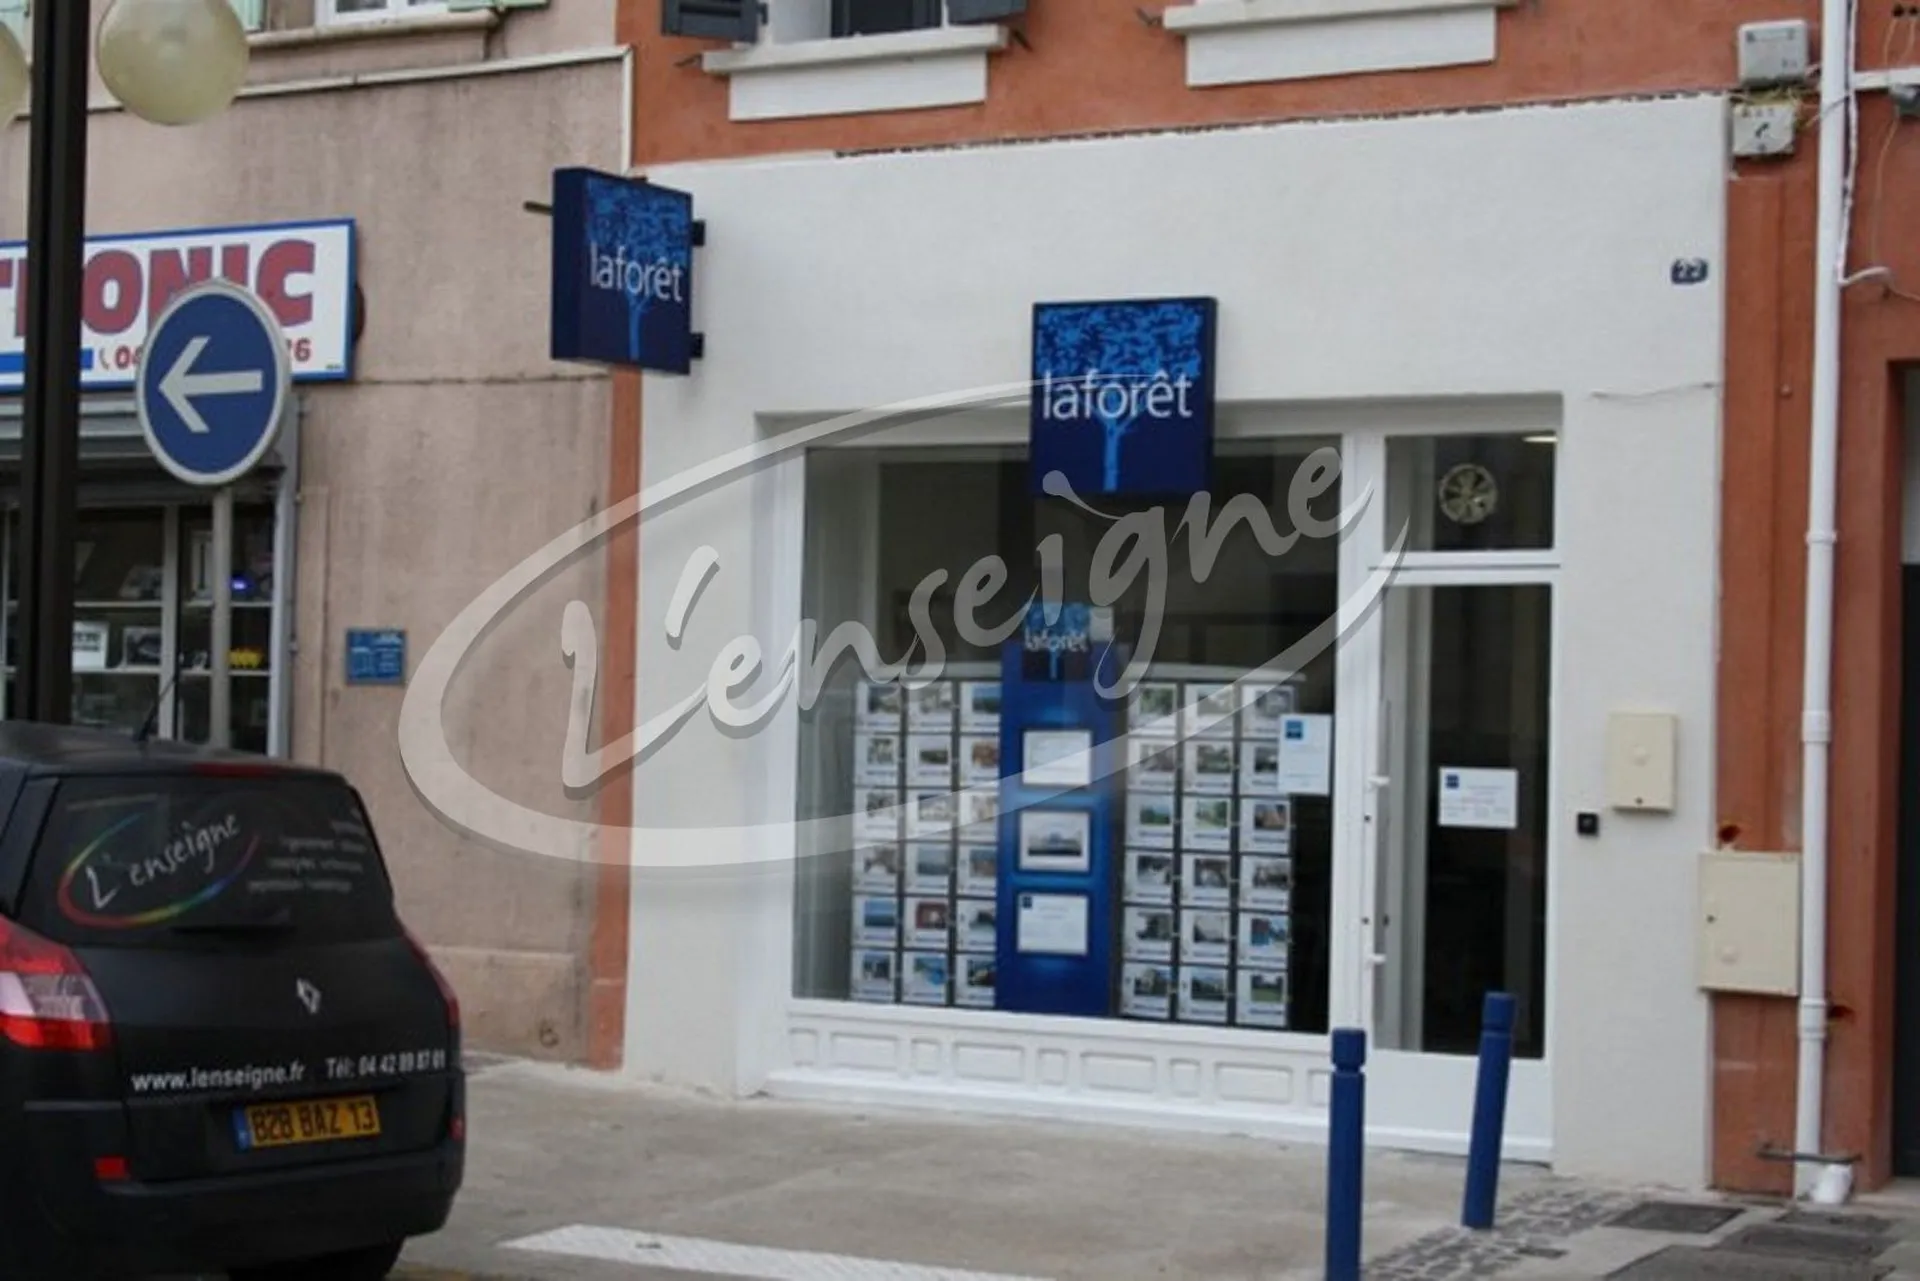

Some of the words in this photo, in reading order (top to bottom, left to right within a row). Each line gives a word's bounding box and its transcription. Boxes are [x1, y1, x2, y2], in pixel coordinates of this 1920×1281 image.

[589, 241, 684, 302] laforêt
[1042, 367, 1194, 420] laforêt
[131, 1057, 305, 1092] www.lenseigne.fr
[346, 1100, 377, 1132] 13
